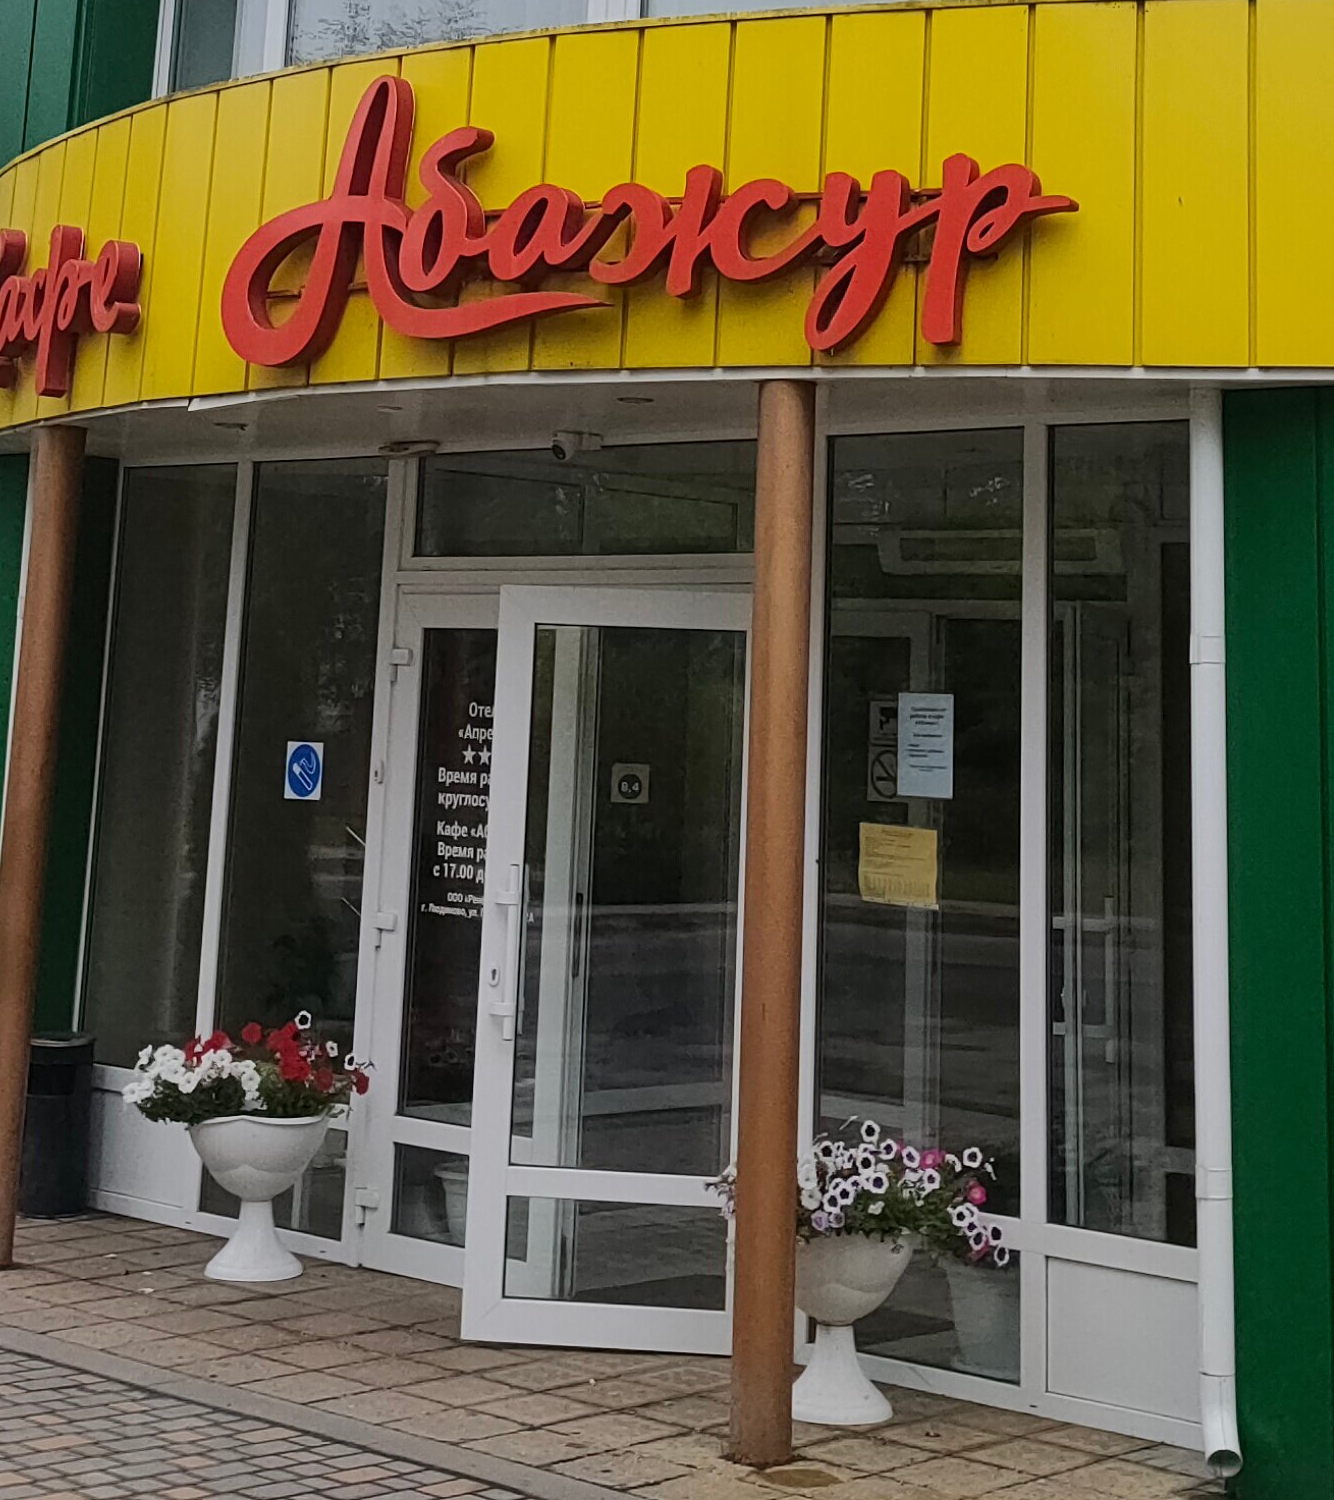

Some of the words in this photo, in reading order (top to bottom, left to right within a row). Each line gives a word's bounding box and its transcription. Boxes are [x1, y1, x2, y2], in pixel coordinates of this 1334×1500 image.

[220, 73, 1080, 367] Абажур
[468, 701, 495, 718] Оте
[458, 723, 494, 744] «Апре
[438, 766, 477, 787] Время
[437, 792, 490, 812] круглосу
[436, 820, 468, 840] Кафе
[437, 841, 474, 860] Время
[443, 863, 474, 879] 17.00
